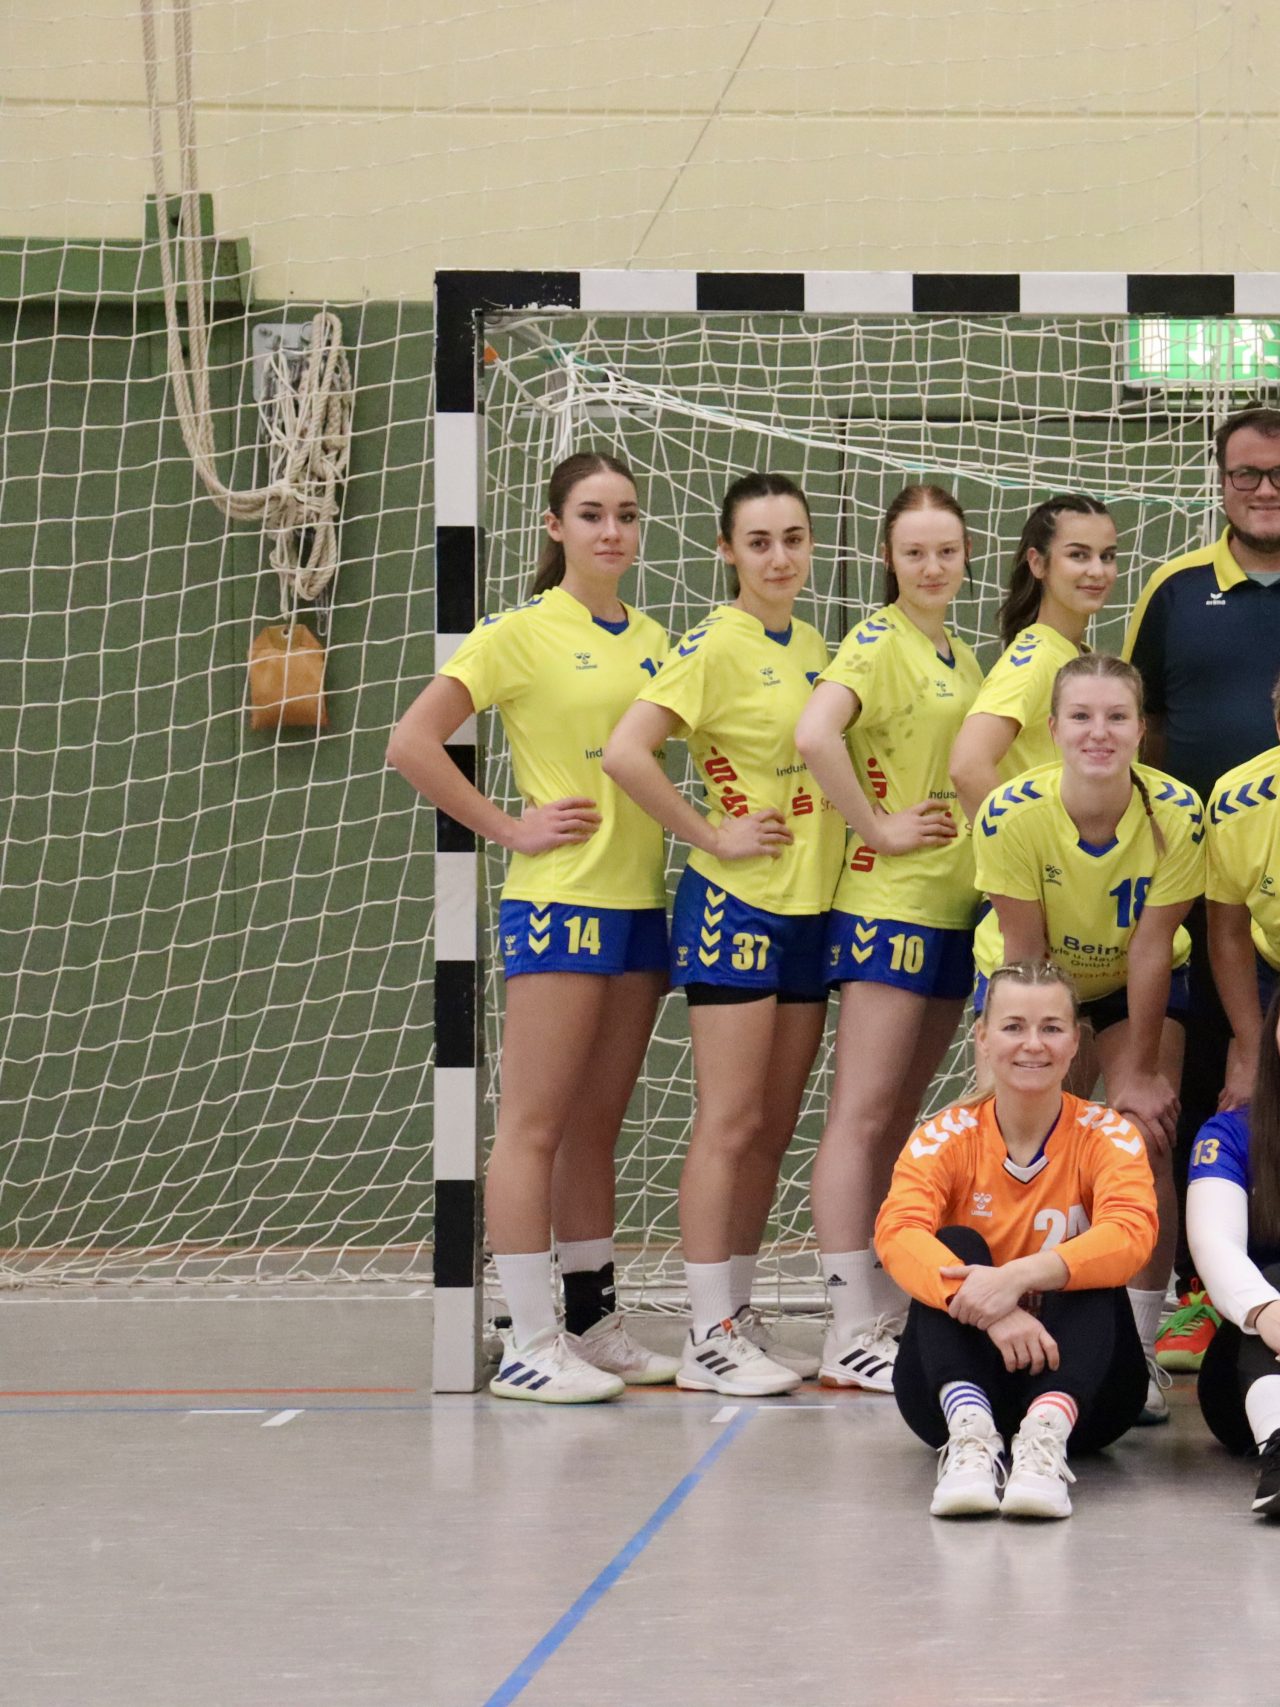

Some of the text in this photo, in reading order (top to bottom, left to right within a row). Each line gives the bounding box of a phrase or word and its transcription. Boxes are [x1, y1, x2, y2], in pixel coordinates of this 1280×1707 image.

[564, 916, 601, 955] 14
[731, 932, 771, 971] 37
[888, 933, 925, 974] 10
[1063, 935, 1119, 955] Bein
[1193, 1138, 1220, 1166] 13
